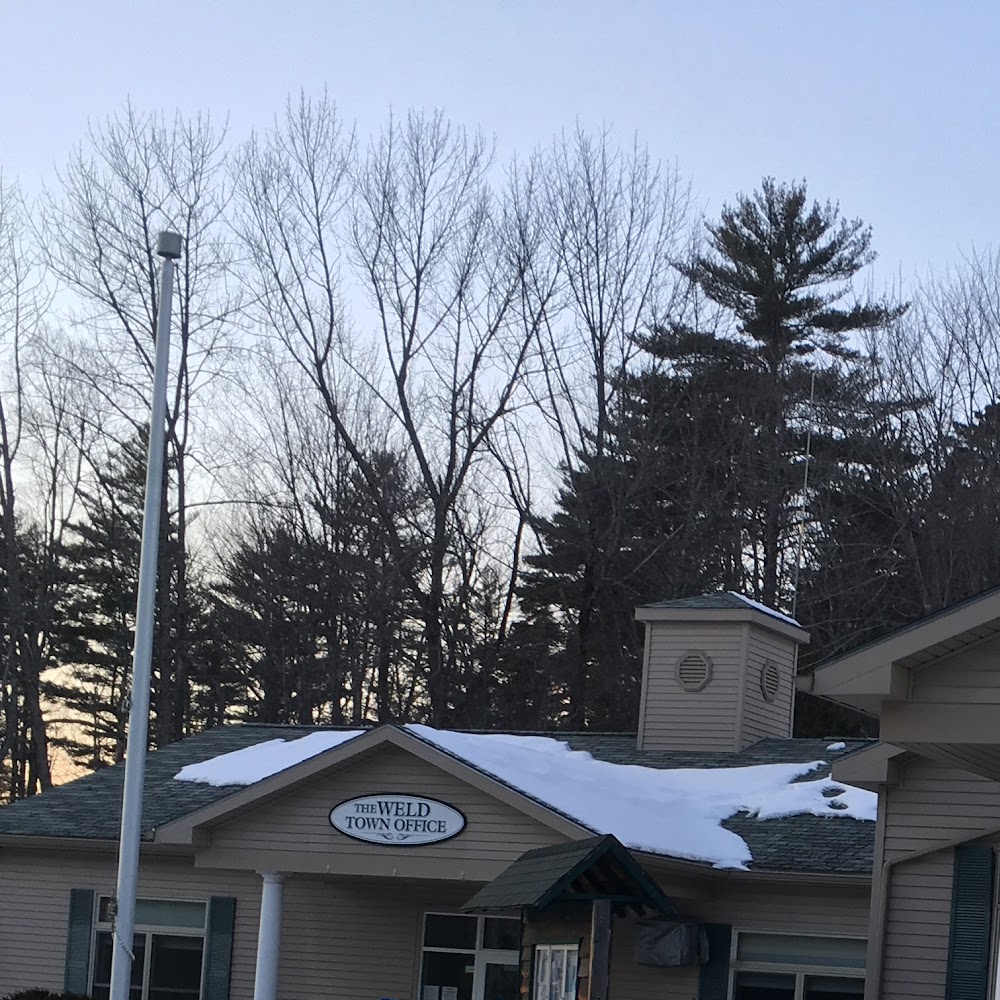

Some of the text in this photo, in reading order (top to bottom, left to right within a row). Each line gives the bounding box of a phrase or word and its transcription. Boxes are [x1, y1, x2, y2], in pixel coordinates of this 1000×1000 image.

[354, 801, 431, 817] THE WELD
[345, 816, 447, 833] TOWN OFFICE
